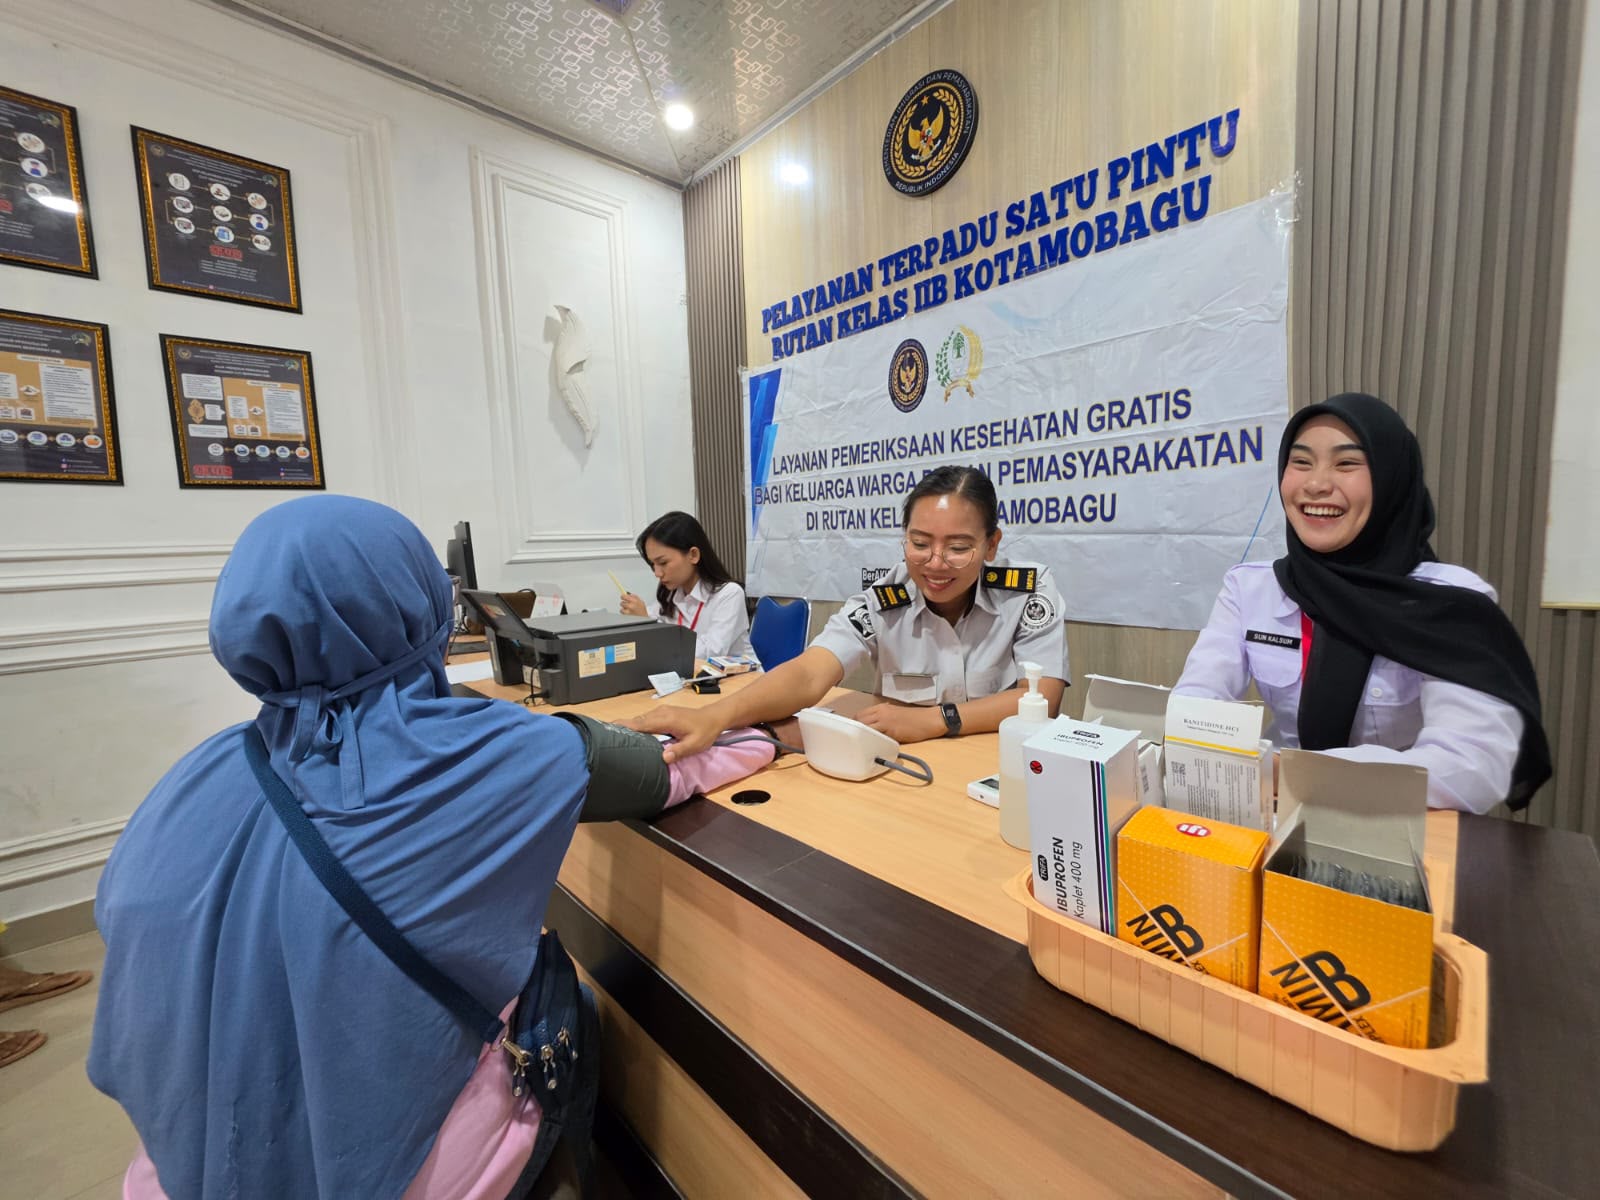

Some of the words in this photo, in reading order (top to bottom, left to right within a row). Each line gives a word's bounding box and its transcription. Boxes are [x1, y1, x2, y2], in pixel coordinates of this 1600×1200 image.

[895, 180, 923, 193] REPUBLIK
[924, 152, 960, 188] INDONESIA
[762, 263, 874, 334] PELAYANAN
[878, 210, 999, 287] TERPADU
[1005, 167, 1099, 239] SATU
[1107, 107, 1240, 200] PINTU
[771, 315, 833, 361] RUTAN
[837, 287, 909, 340] KELAS
[914, 273, 948, 313] IIB
[953, 174, 1212, 300] KOTAMOBAGU
[773, 449, 828, 475] LAYANAN
[831, 430, 945, 468] PEMERIKSAAN
[950, 407, 1079, 453] KESEHATAN
[1086, 388, 1192, 433] GRATIS
[755, 484, 782, 505] BAGI
[785, 477, 855, 502] KELUARGA
[857, 470, 917, 497] WARGA
[998, 425, 1263, 486] PEMASYARAKATAN
[806, 511, 818, 531] DI
[822, 508, 866, 530] RUTAN
[870, 506, 904, 528] KEL
[997, 492, 1117, 525] AMOBAGU
[1253, 633, 1267, 641] SUN
[1267, 635, 1293, 645] KALSUM
[1039, 855, 1048, 879] TRIFA
[1052, 836, 1068, 912] IBUPROFEN
[1070, 861, 1082, 883] 400
[1072, 841, 1083, 860] mg
[1072, 886, 1086, 919] Kaplet
[1149, 904, 1205, 957] B
[1301, 950, 1371, 1011] B
